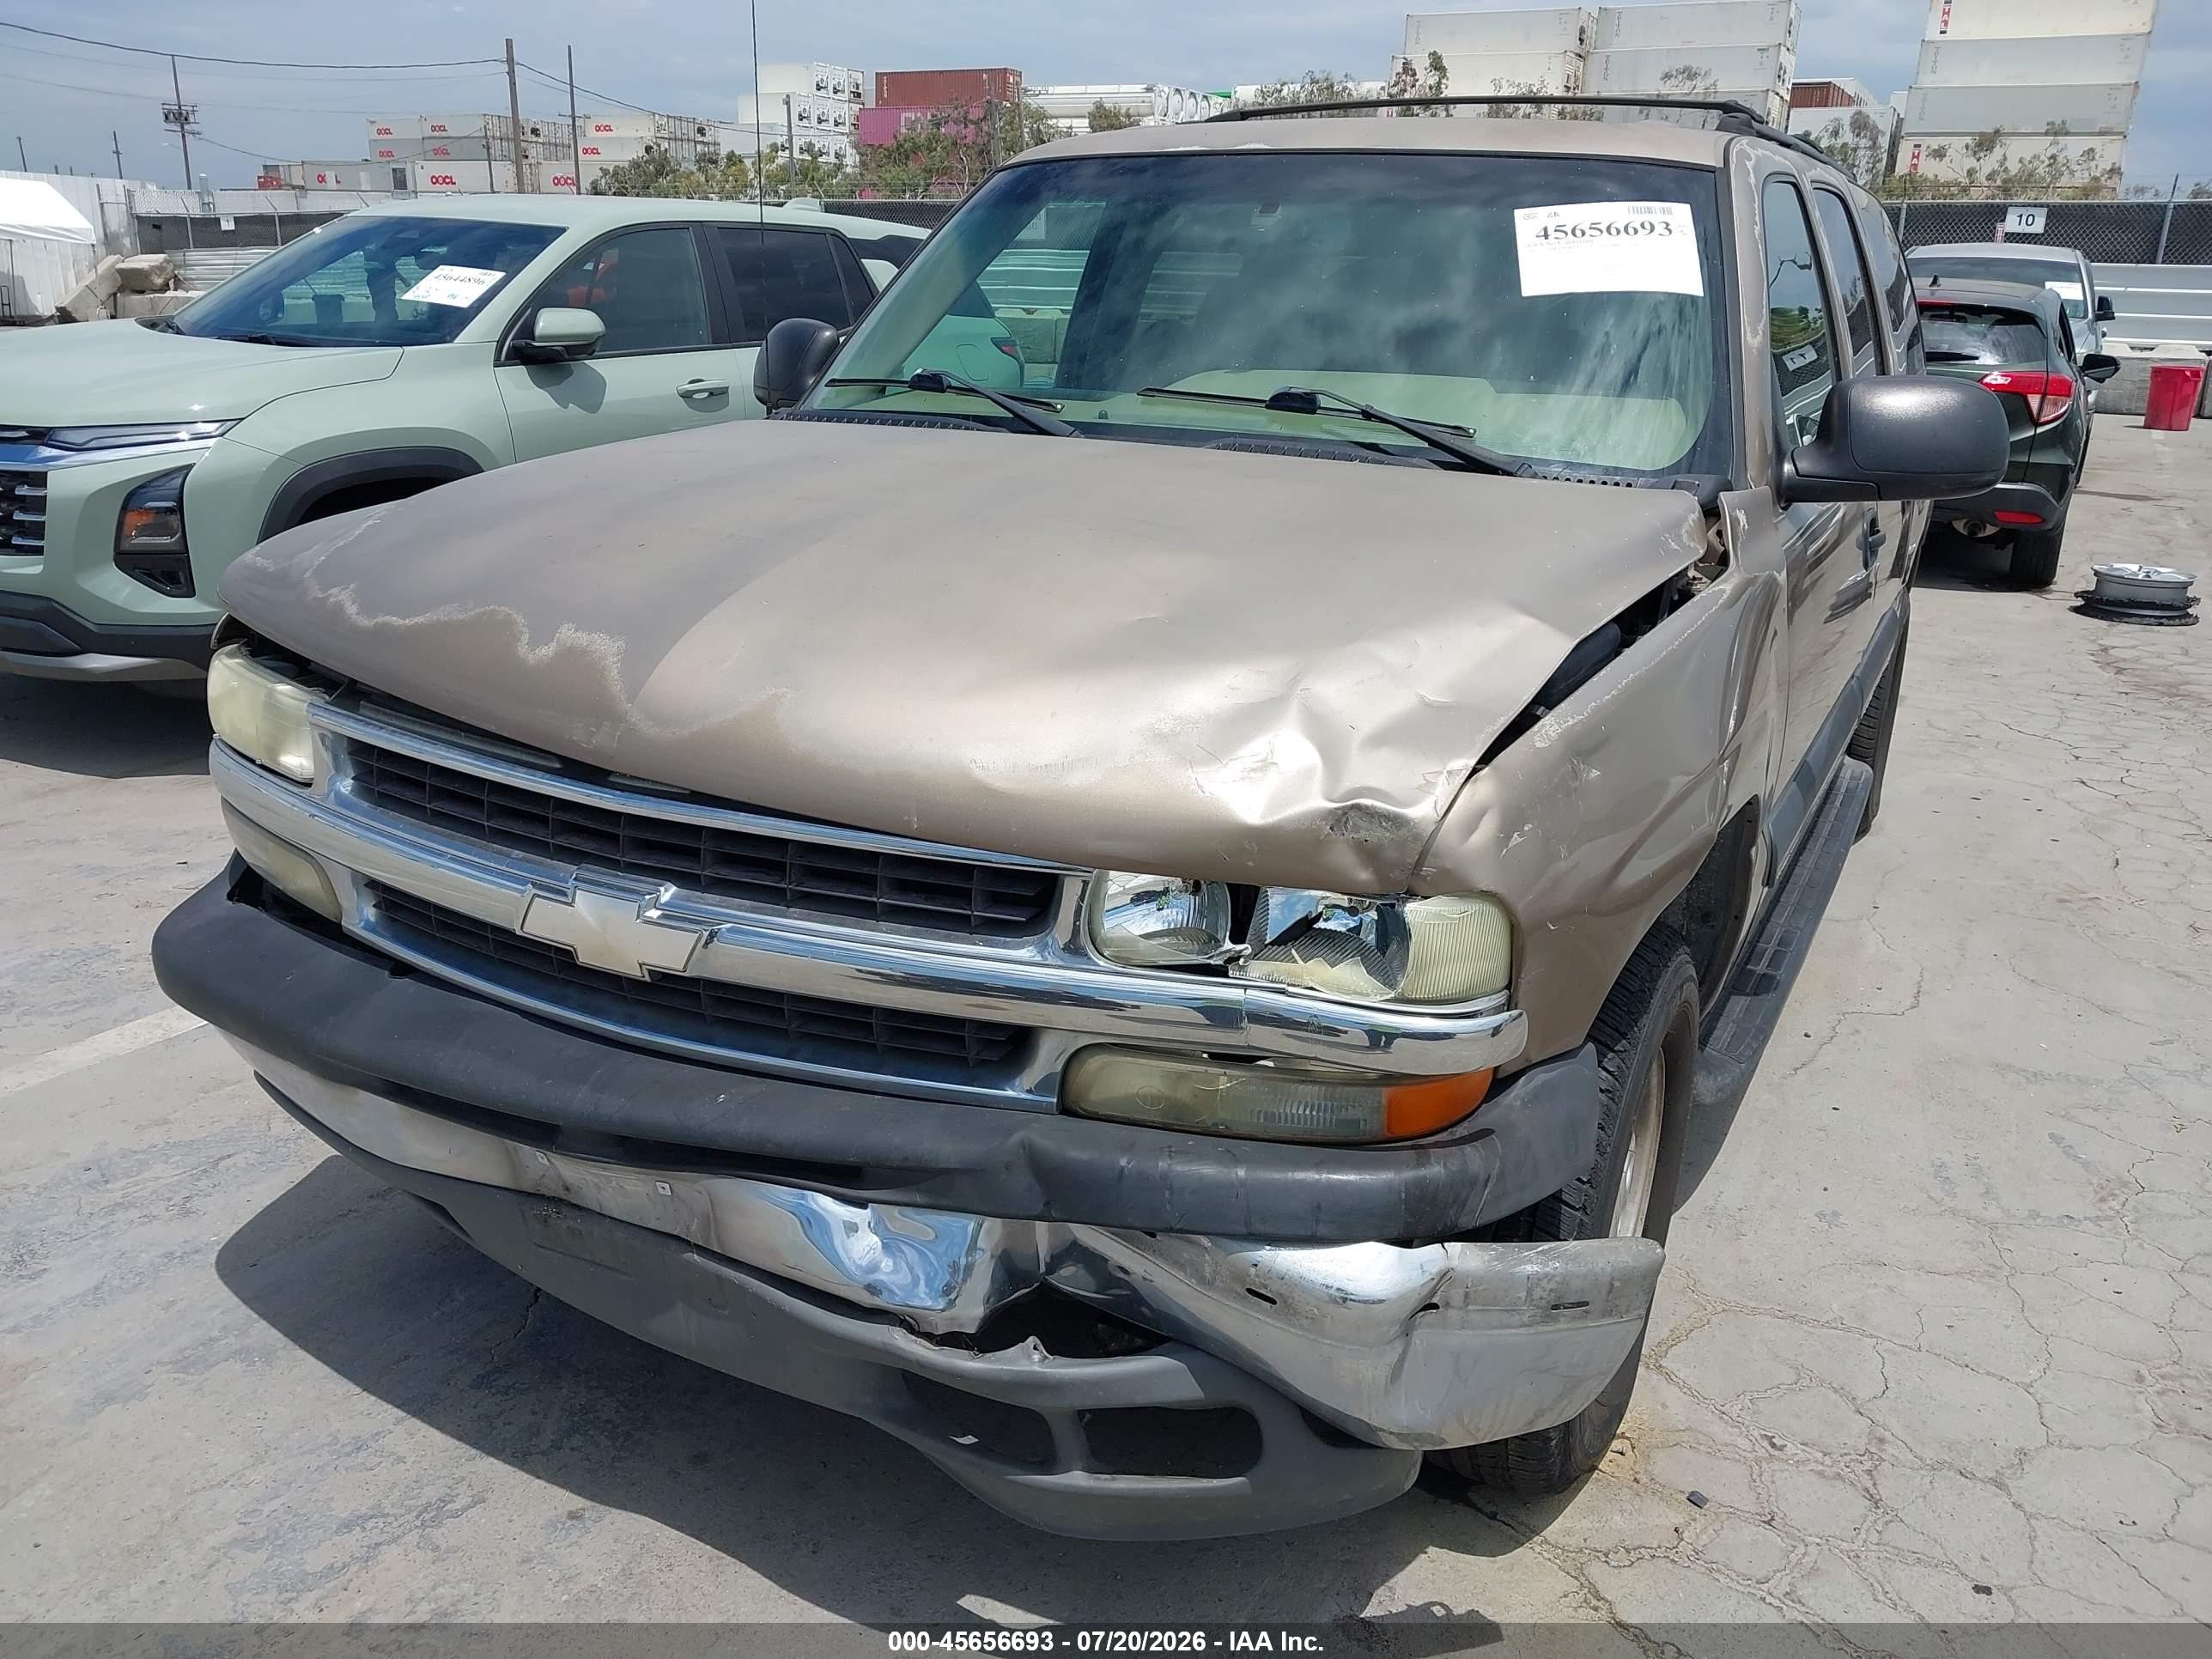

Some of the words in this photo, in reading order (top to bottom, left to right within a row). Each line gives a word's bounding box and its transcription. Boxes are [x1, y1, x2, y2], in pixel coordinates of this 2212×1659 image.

[594, 124, 613, 132] OOCL
[581, 147, 601, 155] OOCL
[430, 175, 457, 185] OOCL
[2016, 213, 2035, 227] 10
[1535, 220, 1673, 240] 45656693
